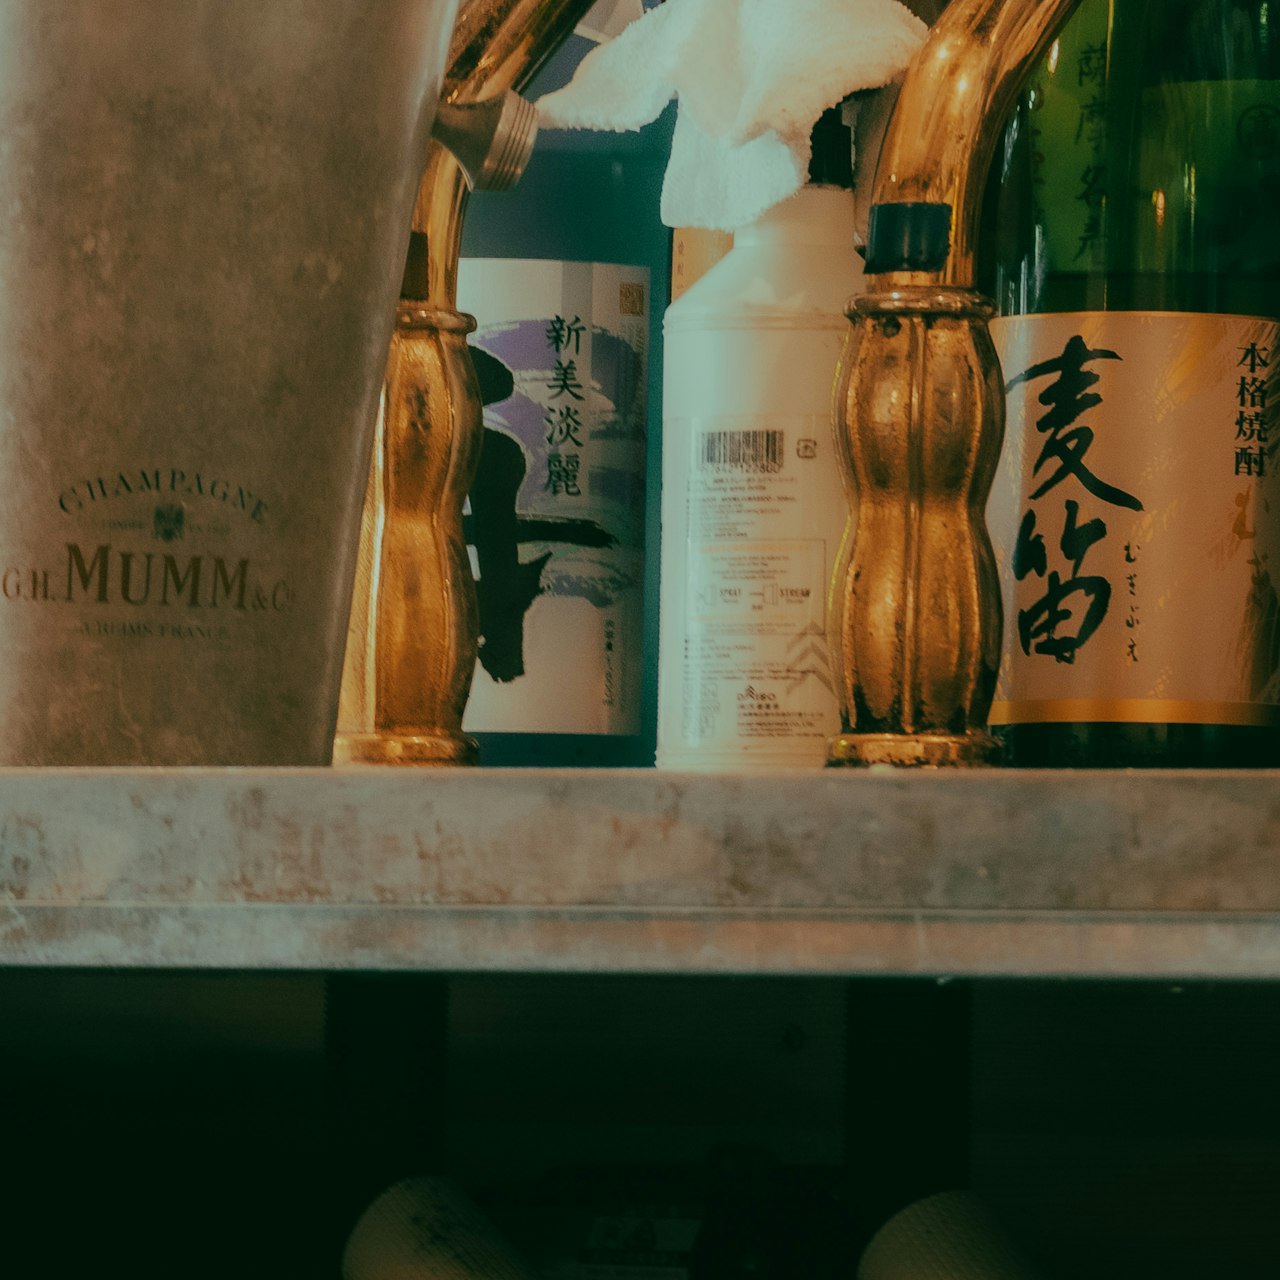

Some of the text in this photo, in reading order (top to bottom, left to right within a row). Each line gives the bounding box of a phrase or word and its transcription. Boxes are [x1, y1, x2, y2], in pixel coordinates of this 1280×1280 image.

[543, 313, 587, 499] 新美淡麗
[58, 467, 271, 524] CHAMPAGNE
[1005, 334, 1145, 665] 麦笛
[64, 541, 251, 612] MUMM
